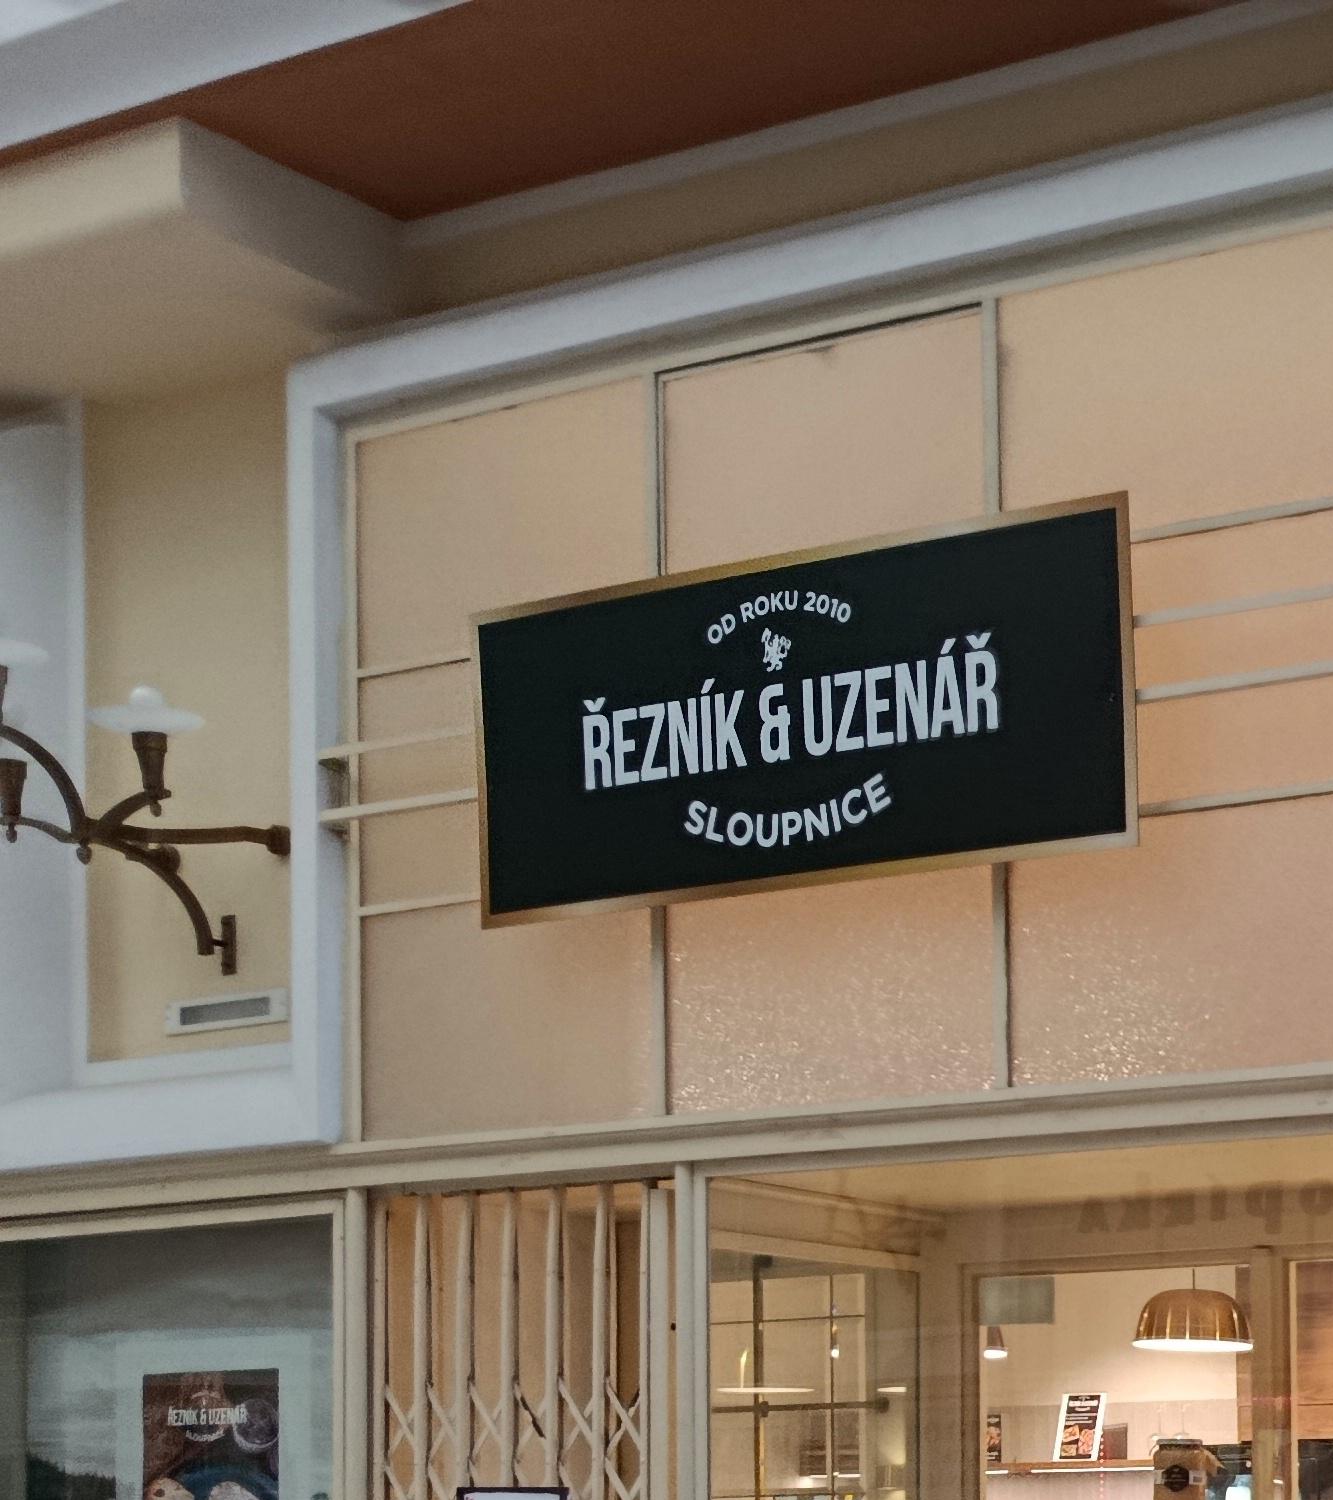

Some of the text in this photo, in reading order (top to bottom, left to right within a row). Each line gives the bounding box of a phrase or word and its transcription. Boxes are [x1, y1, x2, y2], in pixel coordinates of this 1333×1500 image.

[707, 590, 852, 645] OD ROKU 2010
[582, 632, 998, 790] ŘEZNÍK & UZENÁŘ
[683, 773, 892, 847] SLOUPNICE
